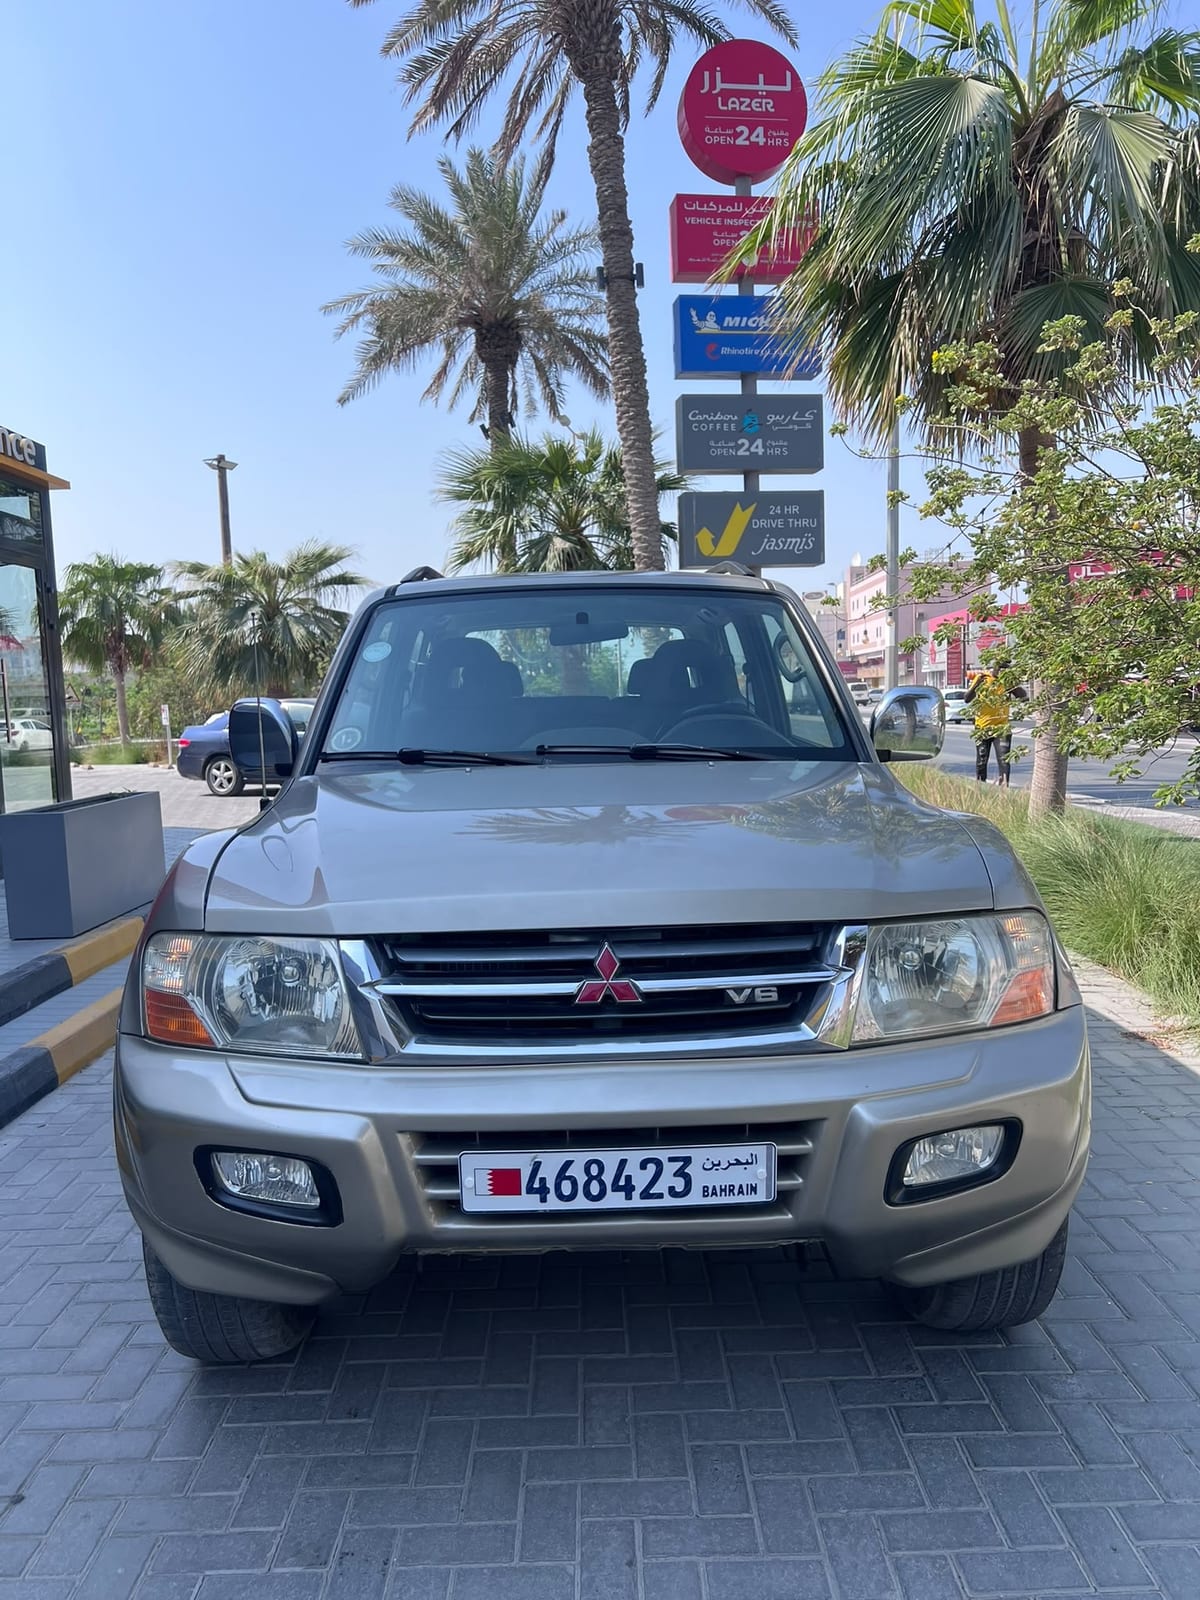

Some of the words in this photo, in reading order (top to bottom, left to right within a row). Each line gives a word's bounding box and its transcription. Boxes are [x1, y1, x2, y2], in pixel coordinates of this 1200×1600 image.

[699, 66, 792, 95] ليزر
[717, 96, 775, 112] LAZER
[704, 136, 734, 145] OPEN
[735, 125, 766, 146] 24
[767, 138, 790, 147] HRS
[684, 216, 722, 226] VEHICLE
[688, 409, 739, 421] Caribou
[691, 423, 737, 432] COFFEE
[709, 448, 736, 456] OPEN
[736, 438, 765, 456] 24
[766, 447, 789, 456] HRS
[769, 505, 781, 514] 24
[784, 505, 800, 514] HR
[751, 518, 784, 528] DRIVE
[788, 518, 817, 528] THRU
[725, 986, 779, 1004] V6
[701, 1152, 758, 1171] البحرين
[525, 1156, 693, 1203] 468423
[701, 1183, 758, 1198] BAHRAIN
